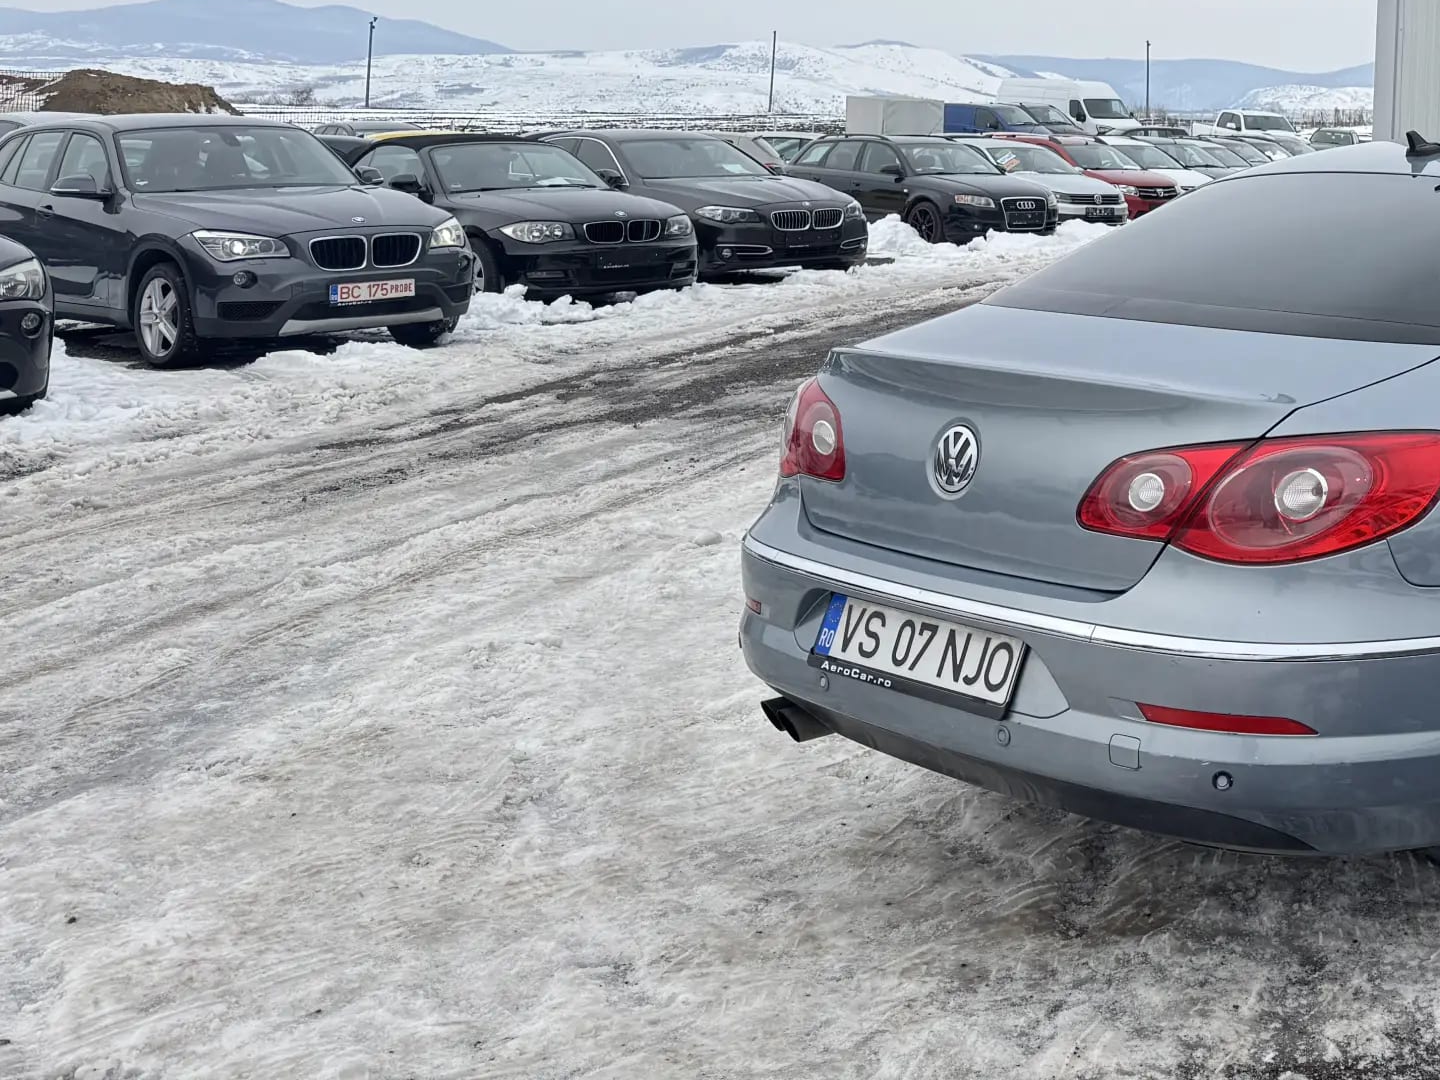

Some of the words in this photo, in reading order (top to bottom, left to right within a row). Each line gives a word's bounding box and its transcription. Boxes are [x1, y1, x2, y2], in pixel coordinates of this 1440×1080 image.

[340, 285, 361, 300] BC
[367, 283, 389, 298] 175
[390, 282, 413, 294] PROBE
[818, 627, 835, 648] RO
[840, 604, 887, 658] VS
[891, 619, 939, 671] 07
[936, 628, 1014, 692] NJO
[820, 659, 892, 688] AeroCar.ro
